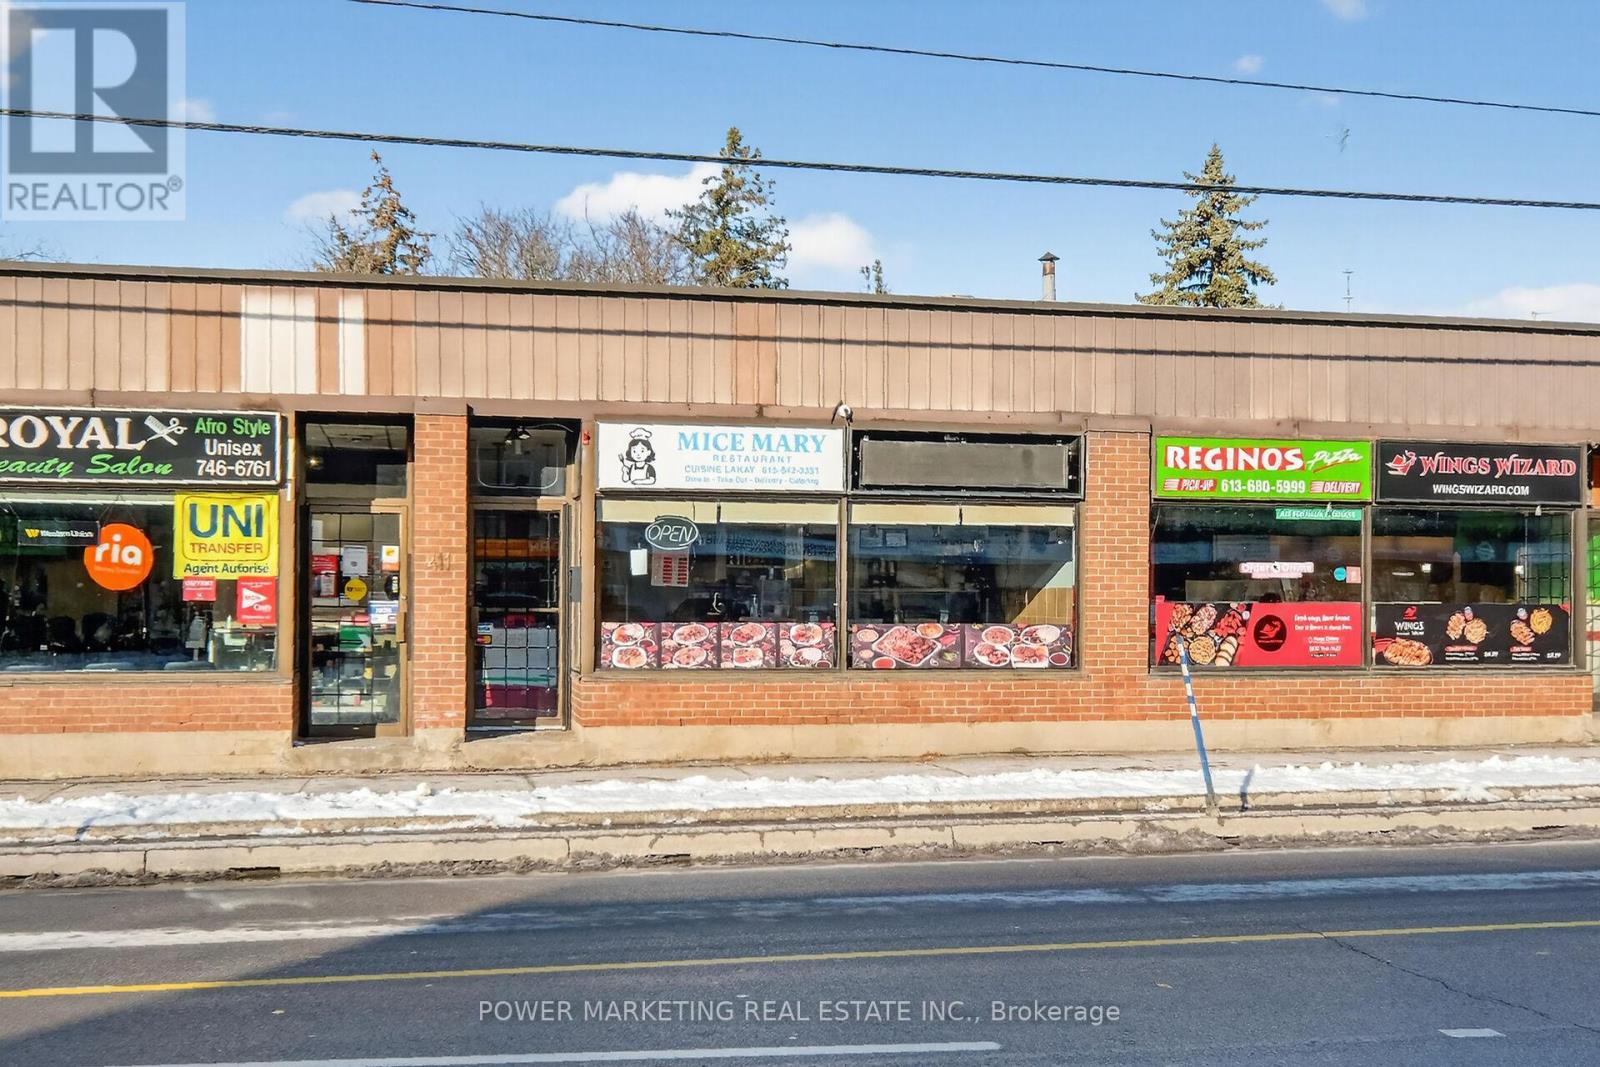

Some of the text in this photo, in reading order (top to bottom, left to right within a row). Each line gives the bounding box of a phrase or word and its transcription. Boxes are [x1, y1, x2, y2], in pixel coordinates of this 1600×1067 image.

[195, 417, 271, 438] Afro Style
[204, 438, 262, 456] Unisex
[677, 431, 828, 454] MICE MARY
[0, 453, 173, 478] eauty Salon
[712, 454, 793, 464] RESTAURANT
[1166, 445, 1305, 471] REGINOS
[1419, 451, 1577, 478] WINGS WIZARD
[196, 459, 271, 477] 746-6761
[684, 465, 722, 474] CUISINE
[1221, 479, 1306, 494] 613-680-5999
[1323, 482, 1361, 494] DELIVERY
[1432, 483, 1530, 496] WINGSWIZARD.COM
[188, 502, 264, 538] UNI
[647, 524, 695, 543] OPEN
[95, 533, 143, 566] ria
[189, 542, 264, 554] TRANSFER
[184, 563, 219, 576] Agent
